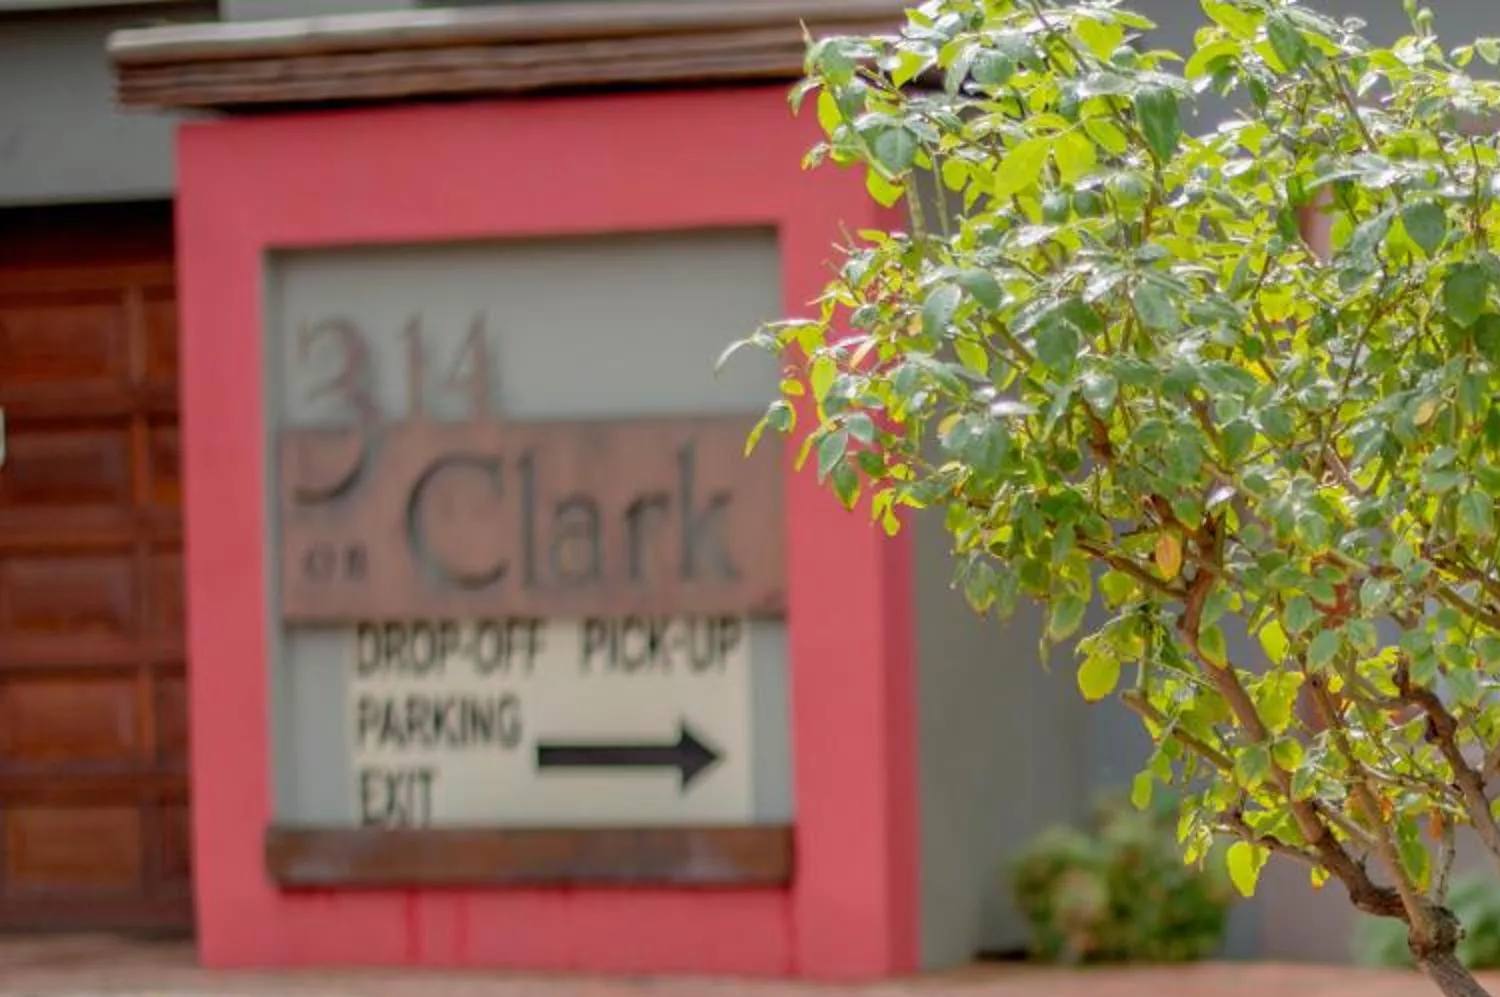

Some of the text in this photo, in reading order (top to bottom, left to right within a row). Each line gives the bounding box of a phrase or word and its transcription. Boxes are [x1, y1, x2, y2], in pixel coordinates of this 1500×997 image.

[406, 434, 743, 592] Clark
[356, 615, 743, 675] DROP-OFF PICK-UP
[356, 694, 523, 748] PARKING
[358, 769, 436, 826] EXIT
